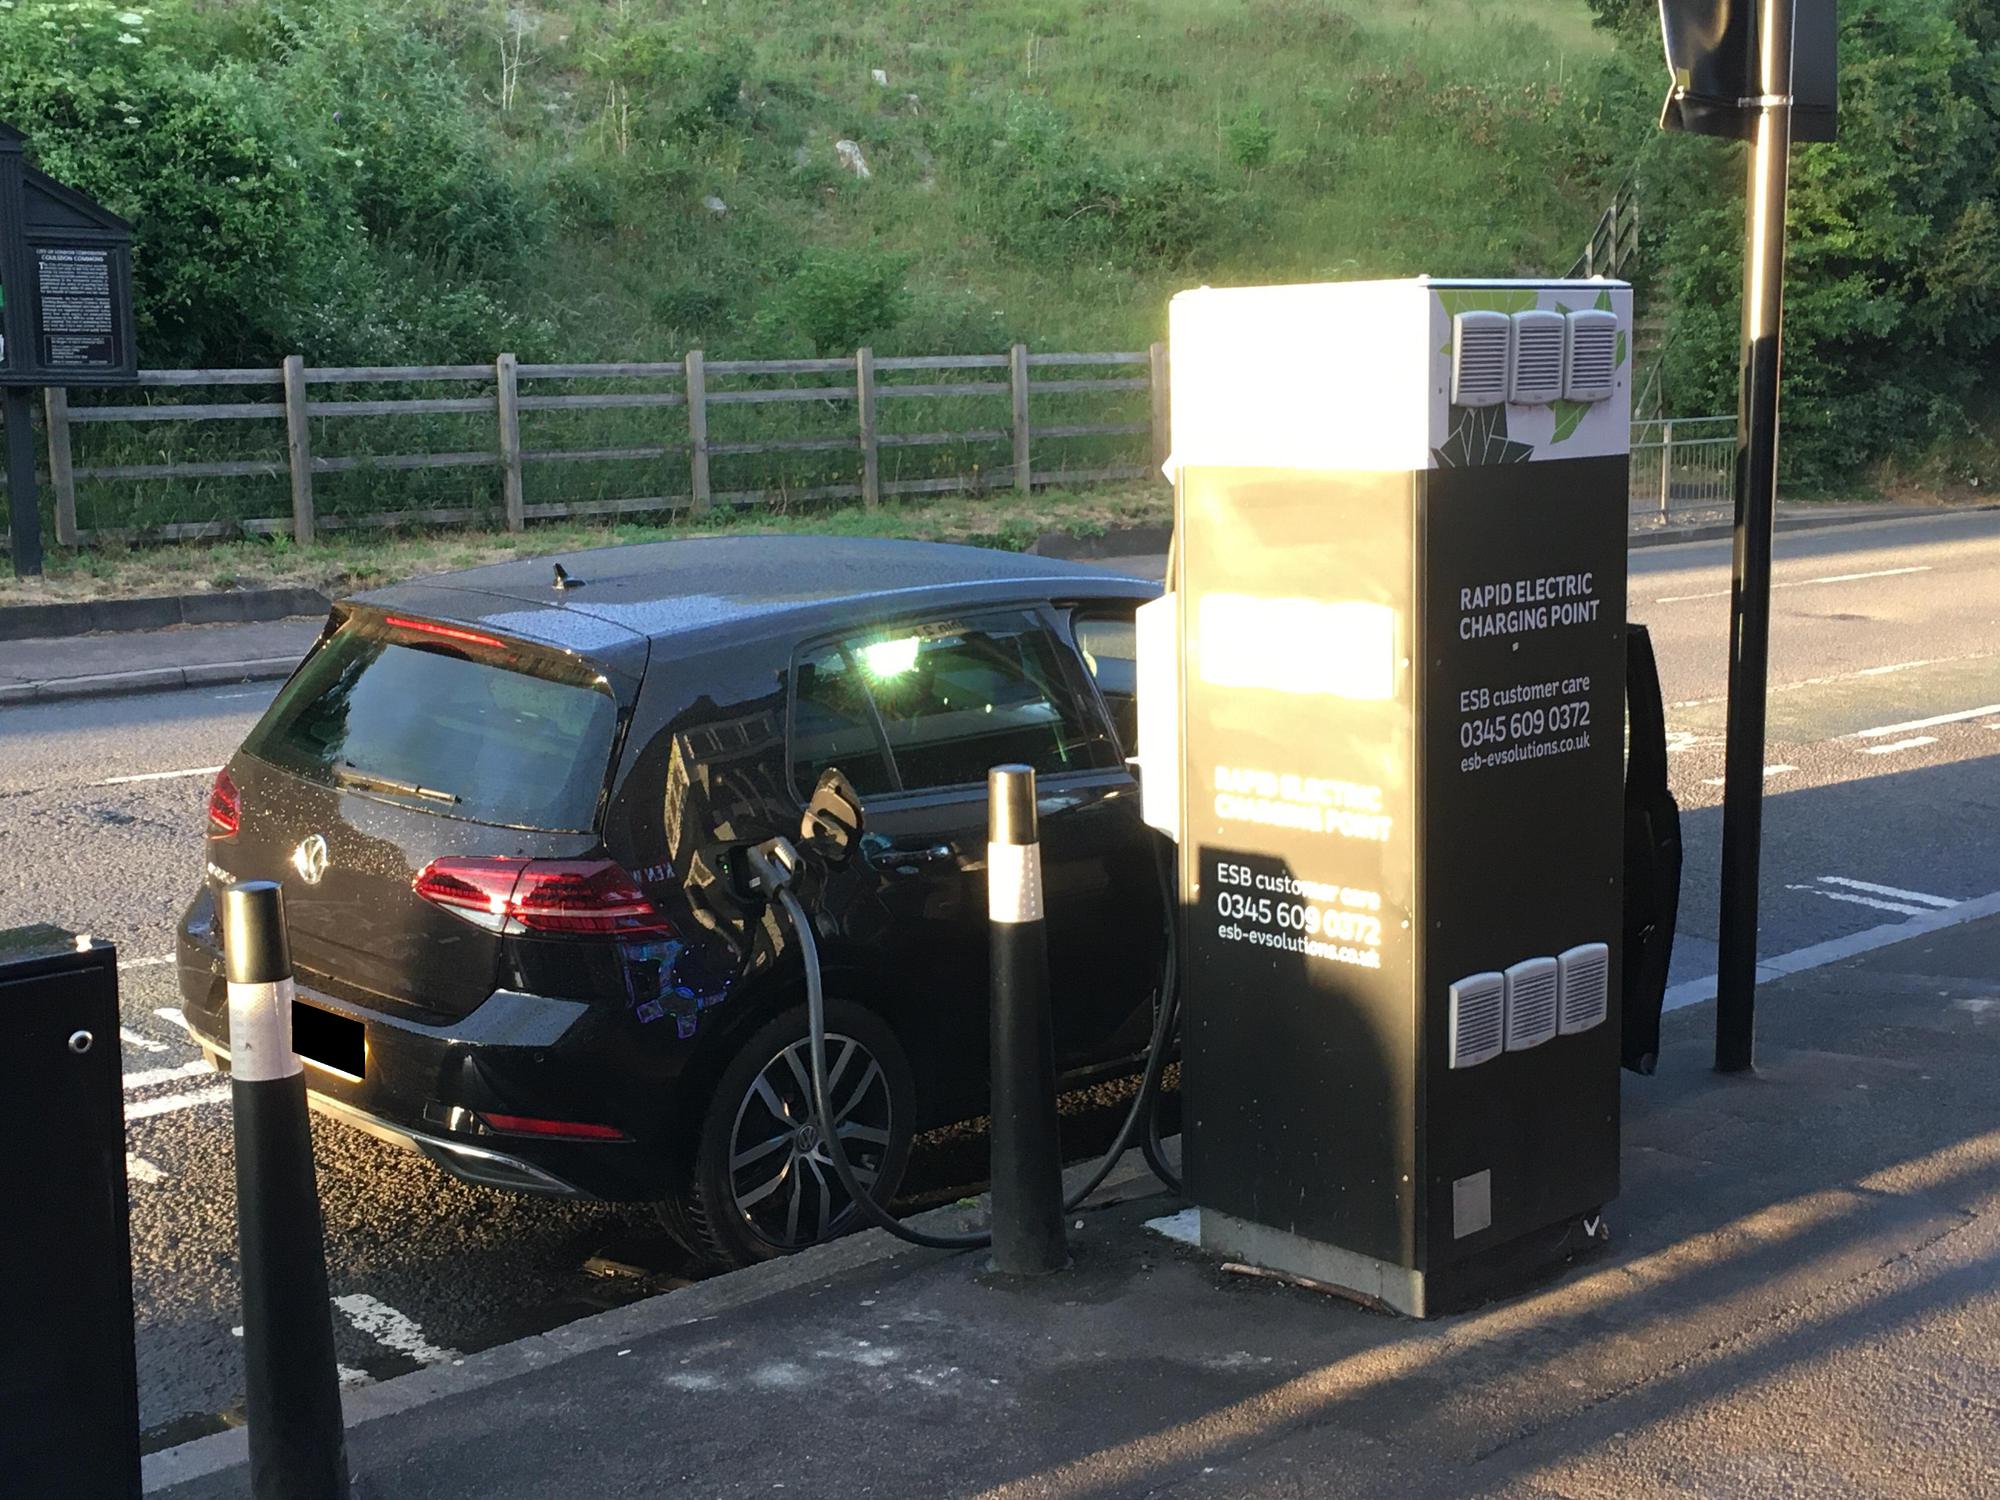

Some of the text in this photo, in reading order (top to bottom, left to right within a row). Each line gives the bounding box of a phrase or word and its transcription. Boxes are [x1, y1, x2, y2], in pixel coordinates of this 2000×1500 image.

[1461, 572, 1593, 611] RAPID ELECTRIC
[1459, 599, 1600, 640] CHARGING POINT
[1460, 676, 1590, 712] ESB customer care
[1460, 701, 1590, 748] 0345 609 0372
[1460, 731, 1590, 772] esb-evsolutions.co.uk
[1217, 862, 1251, 886] ESB
[1217, 892, 1381, 946] 0345 609 0372
